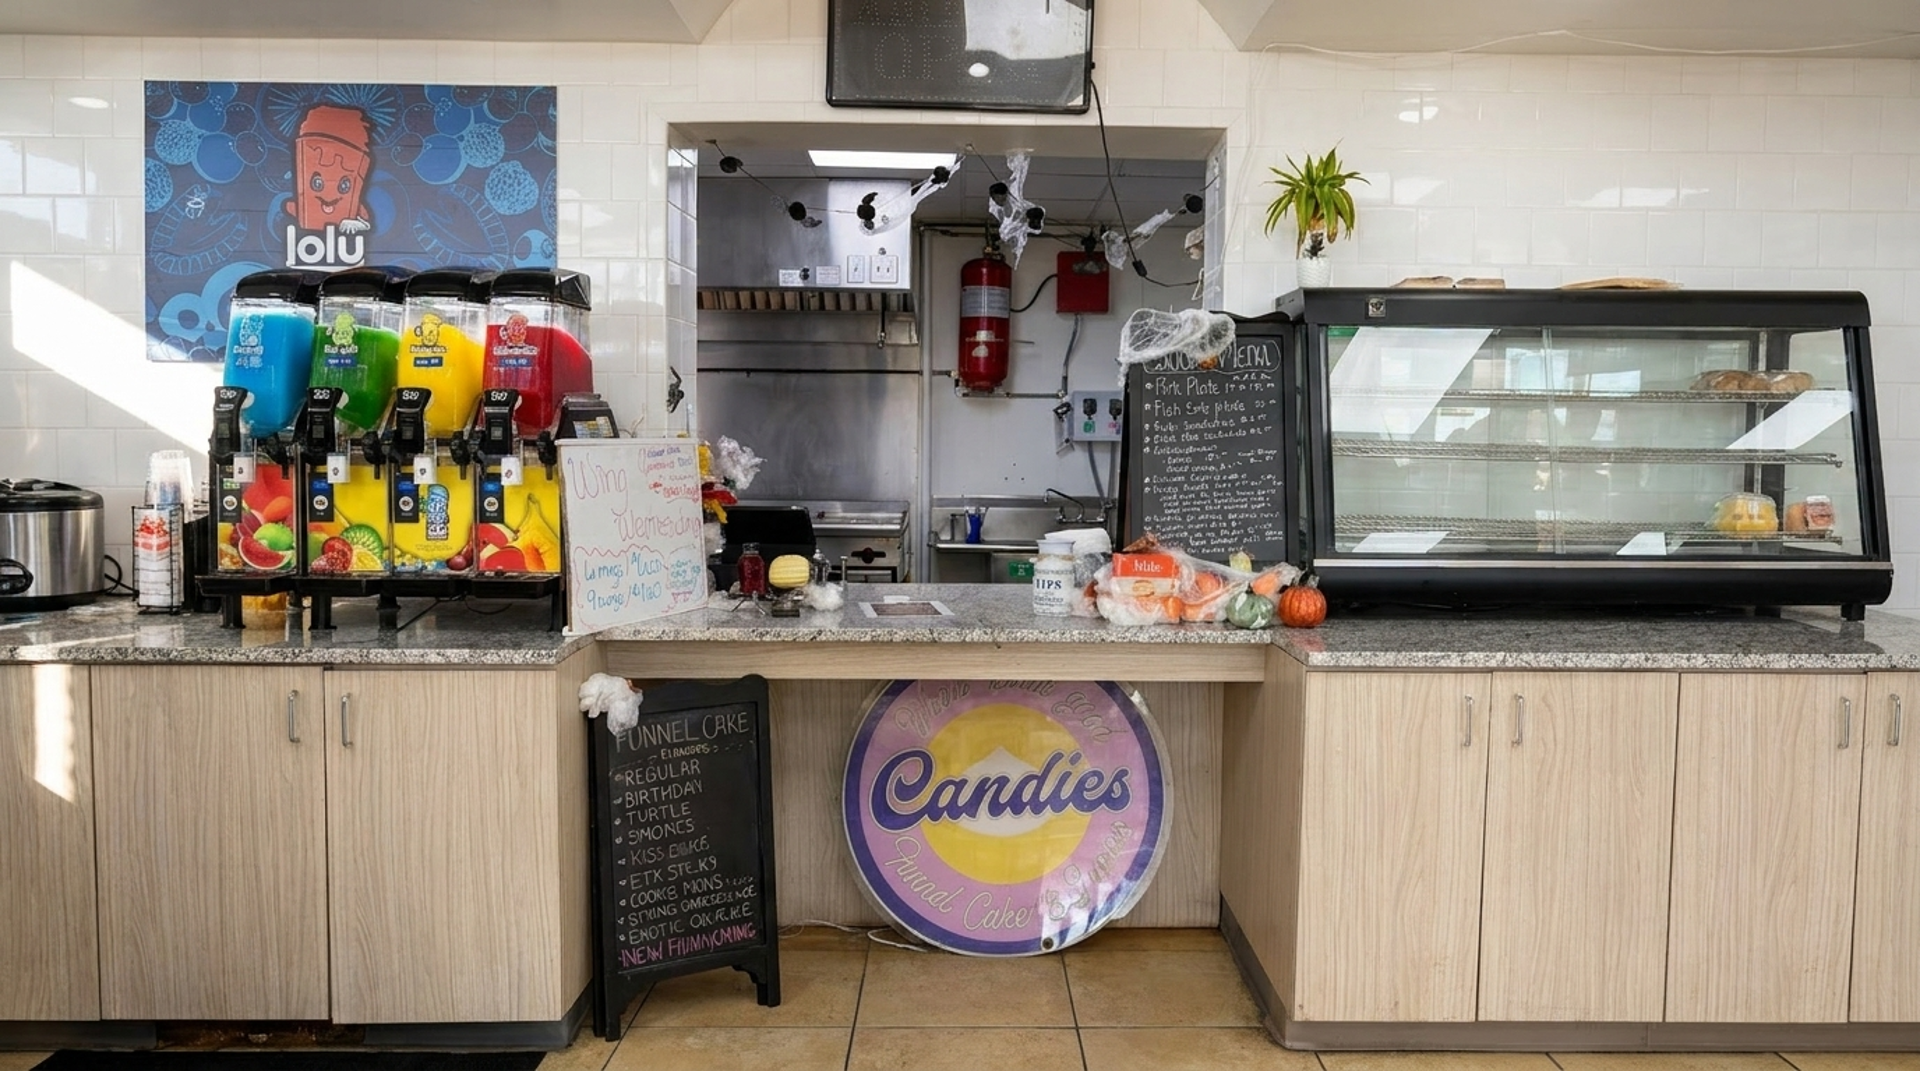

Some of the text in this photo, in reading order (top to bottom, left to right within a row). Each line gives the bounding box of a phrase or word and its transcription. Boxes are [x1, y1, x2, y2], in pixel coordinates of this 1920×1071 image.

[286, 224, 365, 266] lolu
[616, 712, 750, 753] FUNNEL CAKE
[624, 759, 702, 787] REGULAR
[869, 747, 1132, 832] Candies
[625, 779, 703, 809] BIRTHDAY
[626, 802, 692, 826] TURTLE
[963, 891, 1034, 931] Cake
